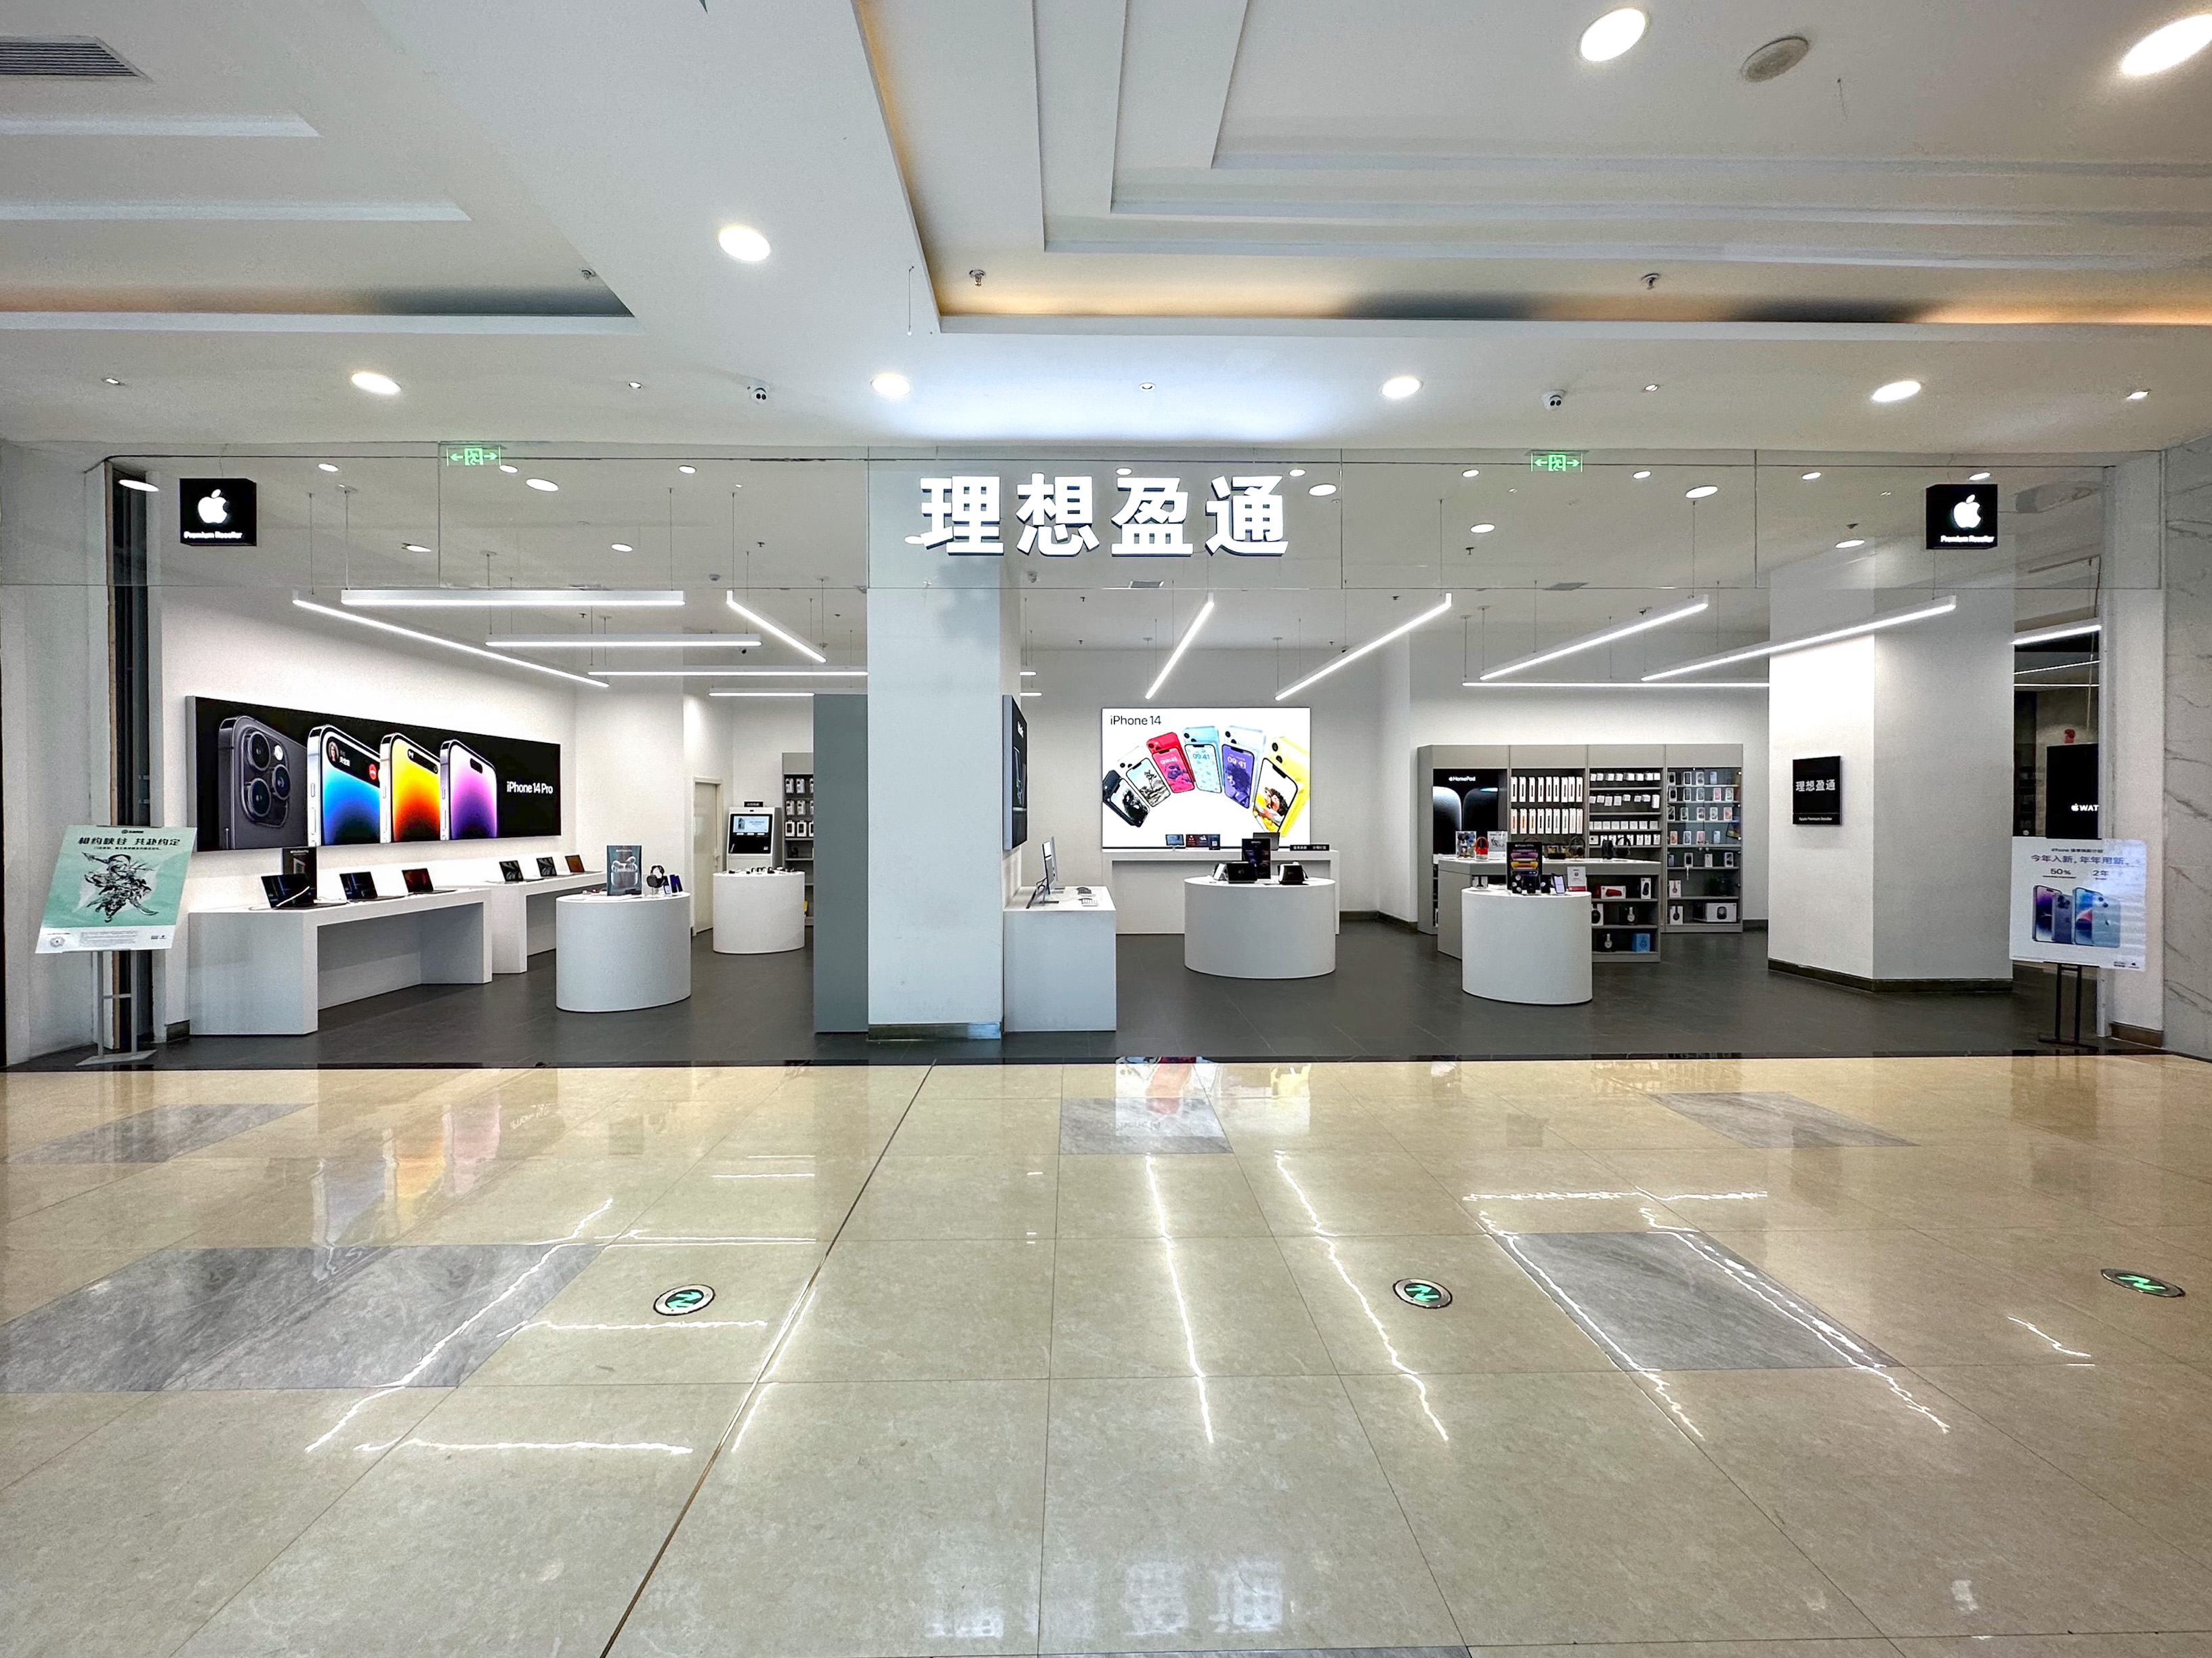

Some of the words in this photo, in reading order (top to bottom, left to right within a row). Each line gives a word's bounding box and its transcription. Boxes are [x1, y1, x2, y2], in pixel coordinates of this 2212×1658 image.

[920, 473, 1289, 557] 理想盈通
[1110, 715, 1148, 725] iPhone
[1149, 715, 1162, 725] 14
[506, 781, 533, 793] iPhone
[533, 782, 541, 793] 14
[541, 783, 554, 794] Pro
[1795, 779, 1835, 792] 理想盈通
